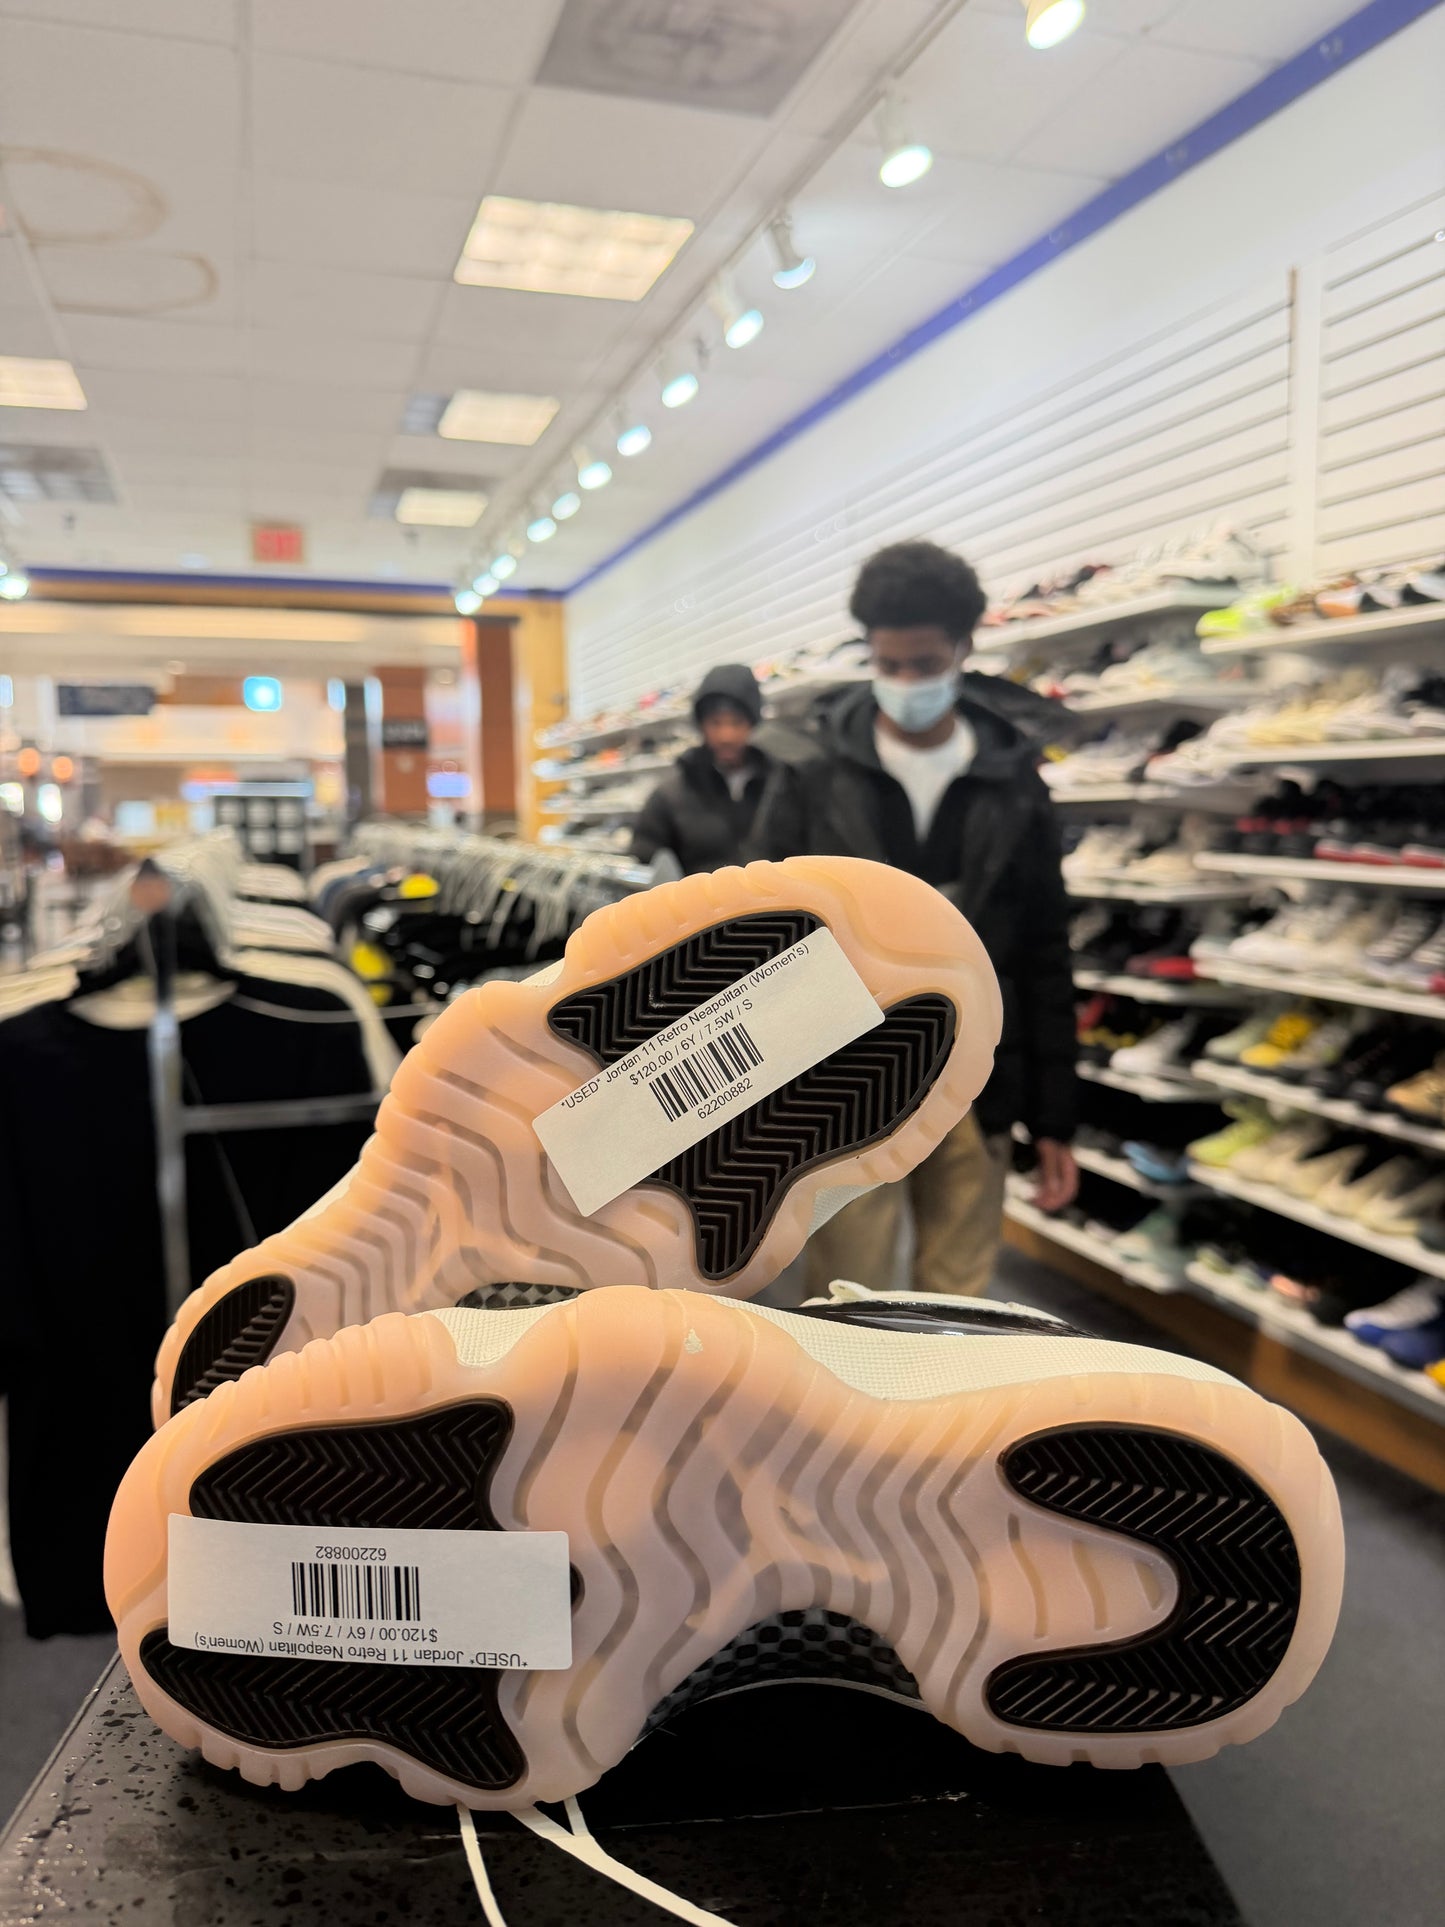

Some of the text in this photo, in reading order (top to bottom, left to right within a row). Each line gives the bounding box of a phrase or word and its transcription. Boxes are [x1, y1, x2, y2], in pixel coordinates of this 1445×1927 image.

[605, 1053, 641, 1083] Jordan
[640, 1040, 656, 1056] 11
[655, 1021, 688, 1046] Retro
[688, 984, 749, 1025] Neapolitan
[747, 941, 809, 988] (Women's)
[628, 997, 753, 1086] $120.00 / 6Y / 7.5W / S
[696, 1076, 753, 1119] 62200882
[314, 1545, 387, 1561] 62200882
[271, 1620, 438, 1643] $120.00 / 6Y / 7.5W / S
[194, 1632, 264, 1653] (Women's)
[268, 1640, 343, 1659] Neapolitan
[346, 1645, 386, 1661] Retro
[392, 1647, 408, 1662] 11
[413, 1648, 464, 1664] Jordan
